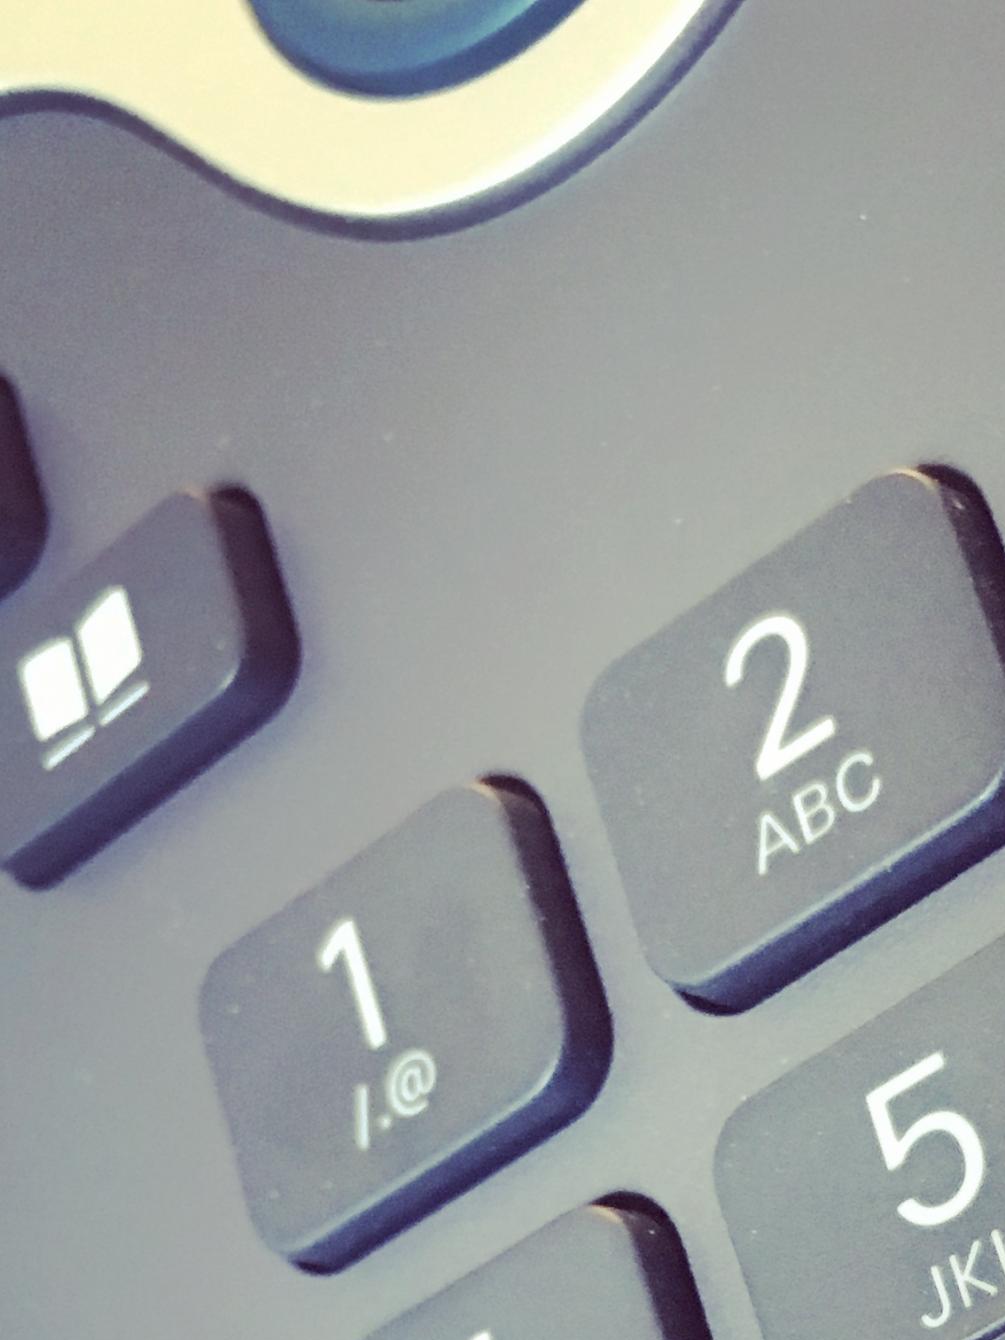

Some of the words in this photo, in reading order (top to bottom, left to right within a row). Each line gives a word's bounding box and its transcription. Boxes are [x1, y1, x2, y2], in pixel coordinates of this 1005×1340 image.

[724, 614, 837, 781] 2
[757, 751, 882, 876] ABC
[318, 919, 387, 1049] 1
[865, 1051, 985, 1227] 5
